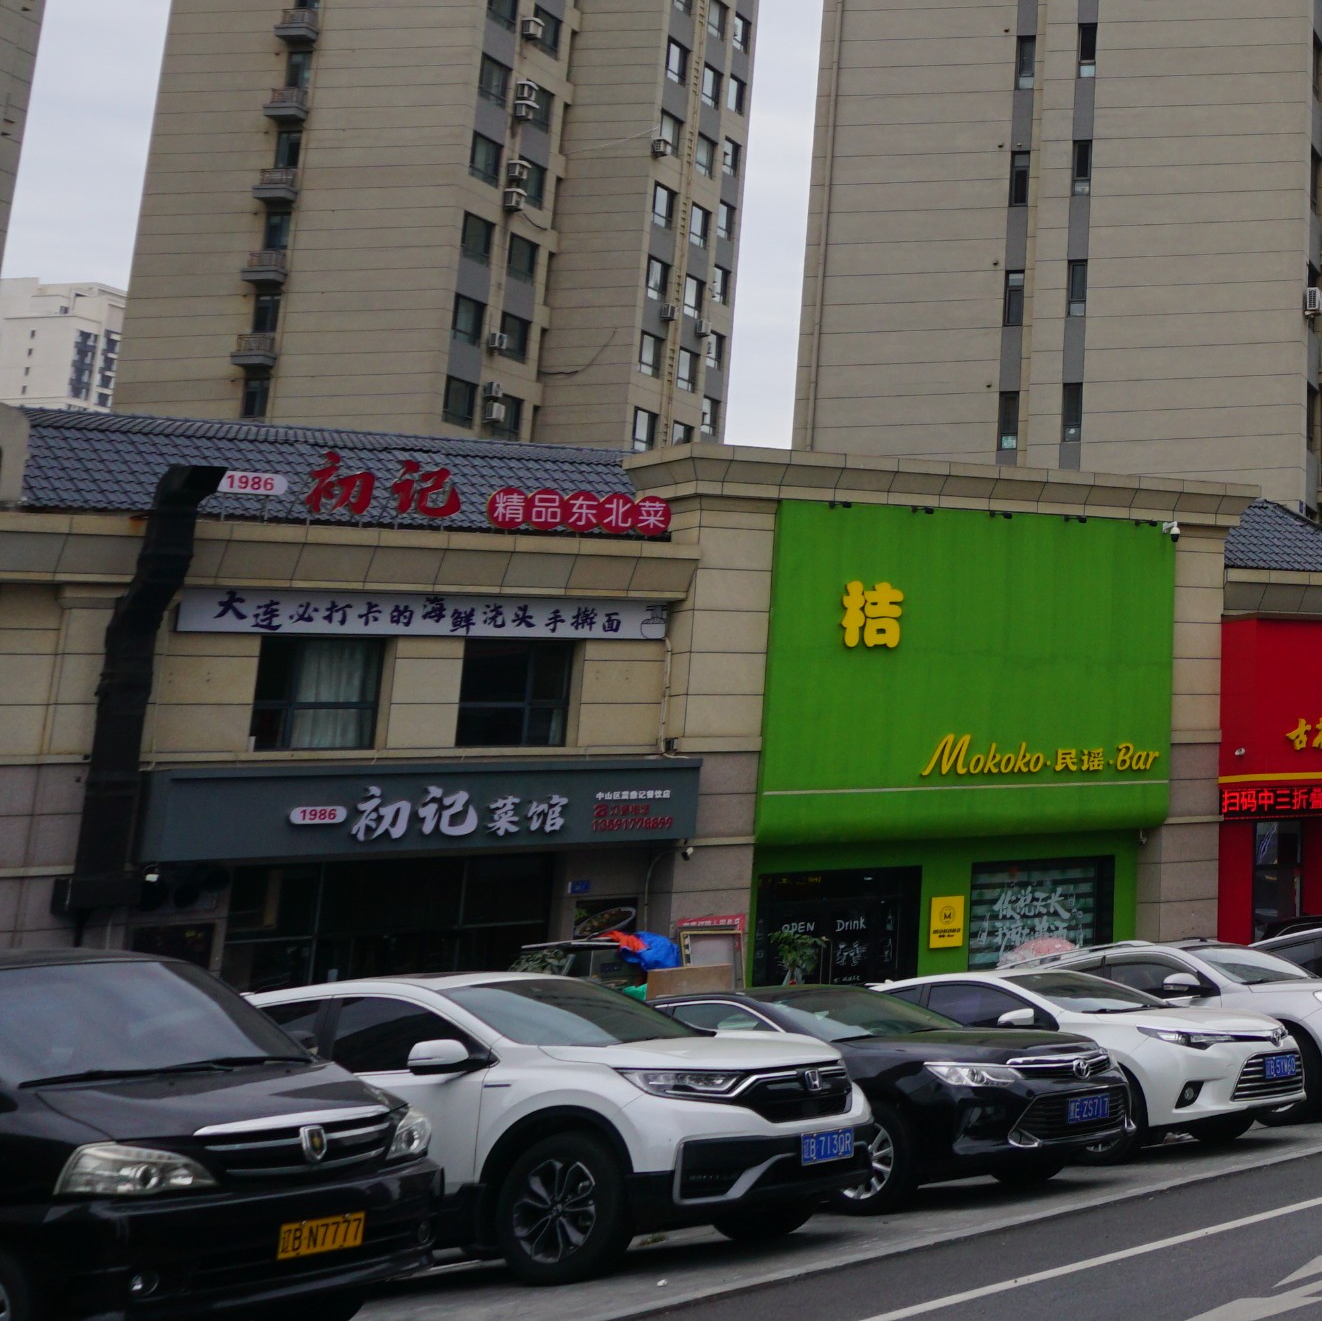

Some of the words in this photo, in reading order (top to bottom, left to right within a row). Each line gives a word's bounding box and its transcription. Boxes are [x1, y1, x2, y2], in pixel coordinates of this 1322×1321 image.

[225, 473, 275, 493] 1986
[305, 450, 462, 519] 初记
[491, 491, 667, 530] 精品东北菜
[213, 590, 622, 635] 大连必打卡的海鲜浇头手擀面
[299, 807, 338, 822] 1986
[835, 916, 867, 933] Drink
